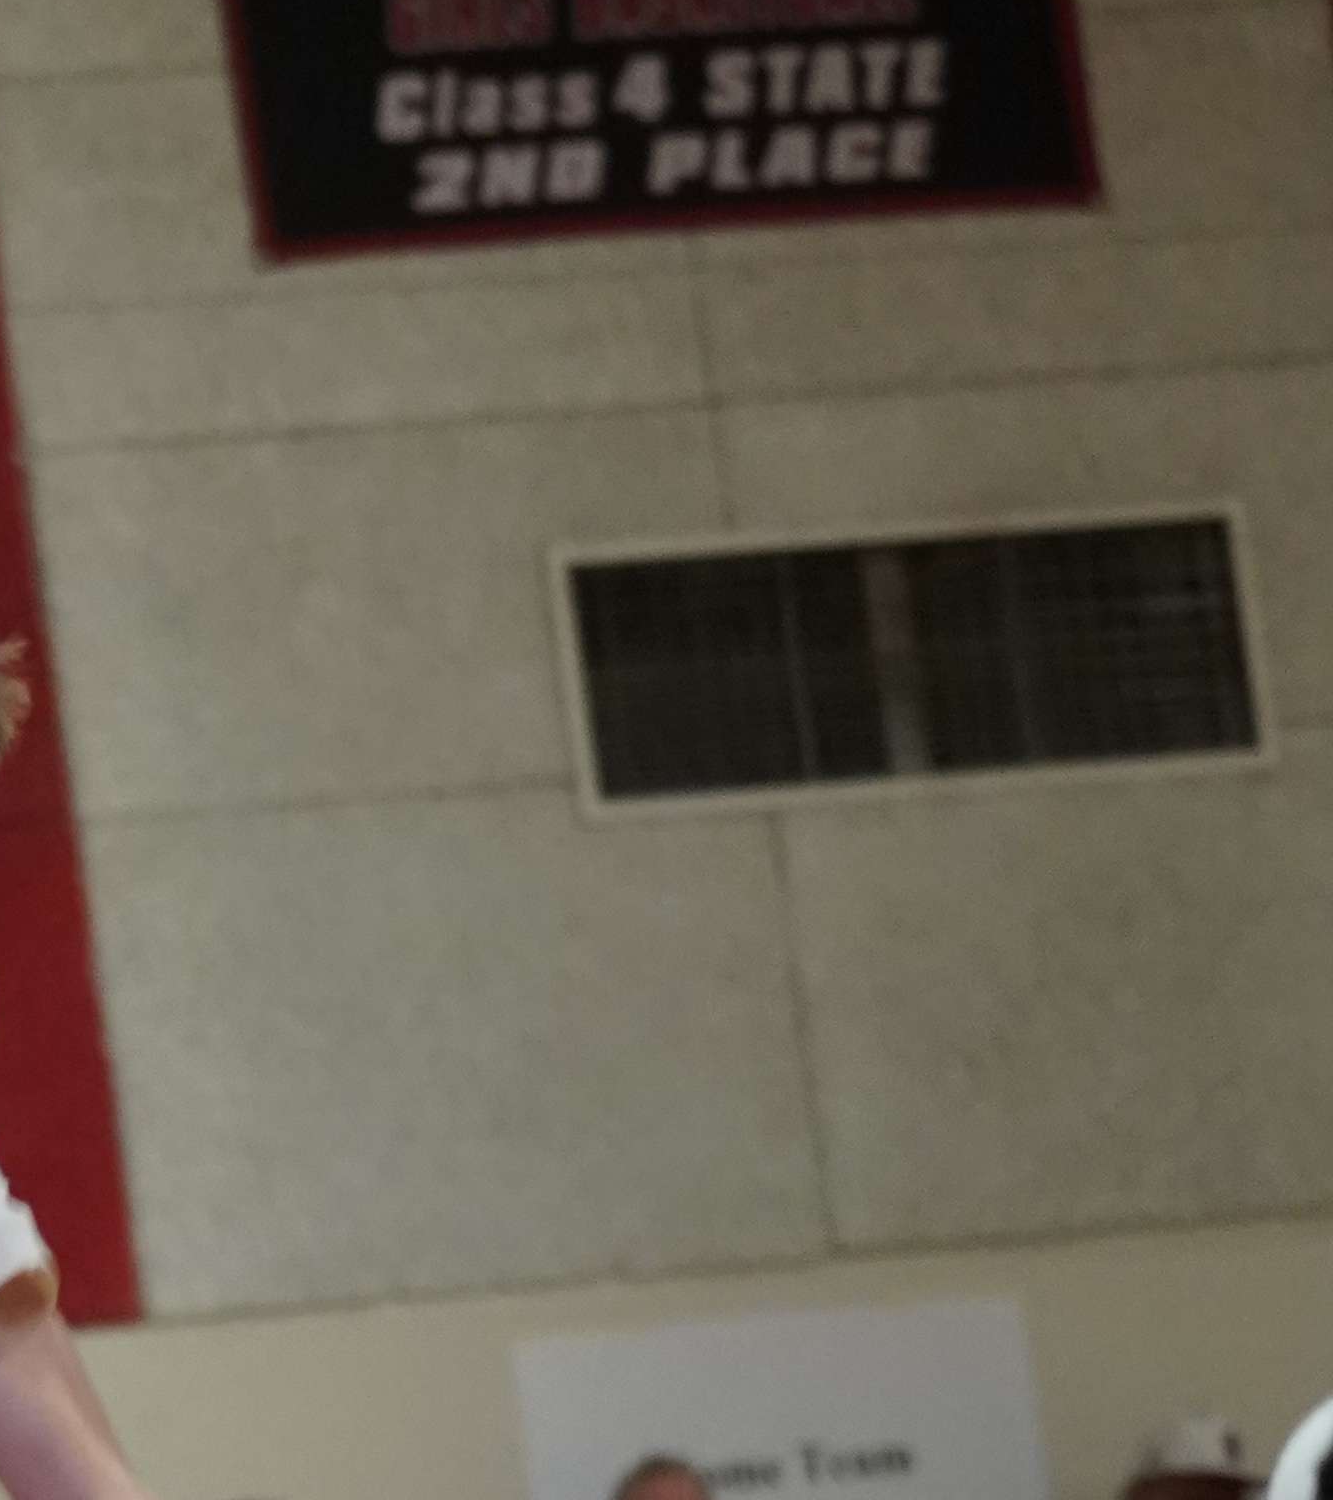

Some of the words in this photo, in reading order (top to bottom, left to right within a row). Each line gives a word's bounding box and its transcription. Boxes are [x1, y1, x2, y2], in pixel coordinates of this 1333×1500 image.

[374, 66, 600, 145] Class
[612, 50, 669, 123] 4
[703, 35, 949, 119] STATE
[409, 134, 610, 216] 2ND
[643, 119, 936, 198] PLACE
